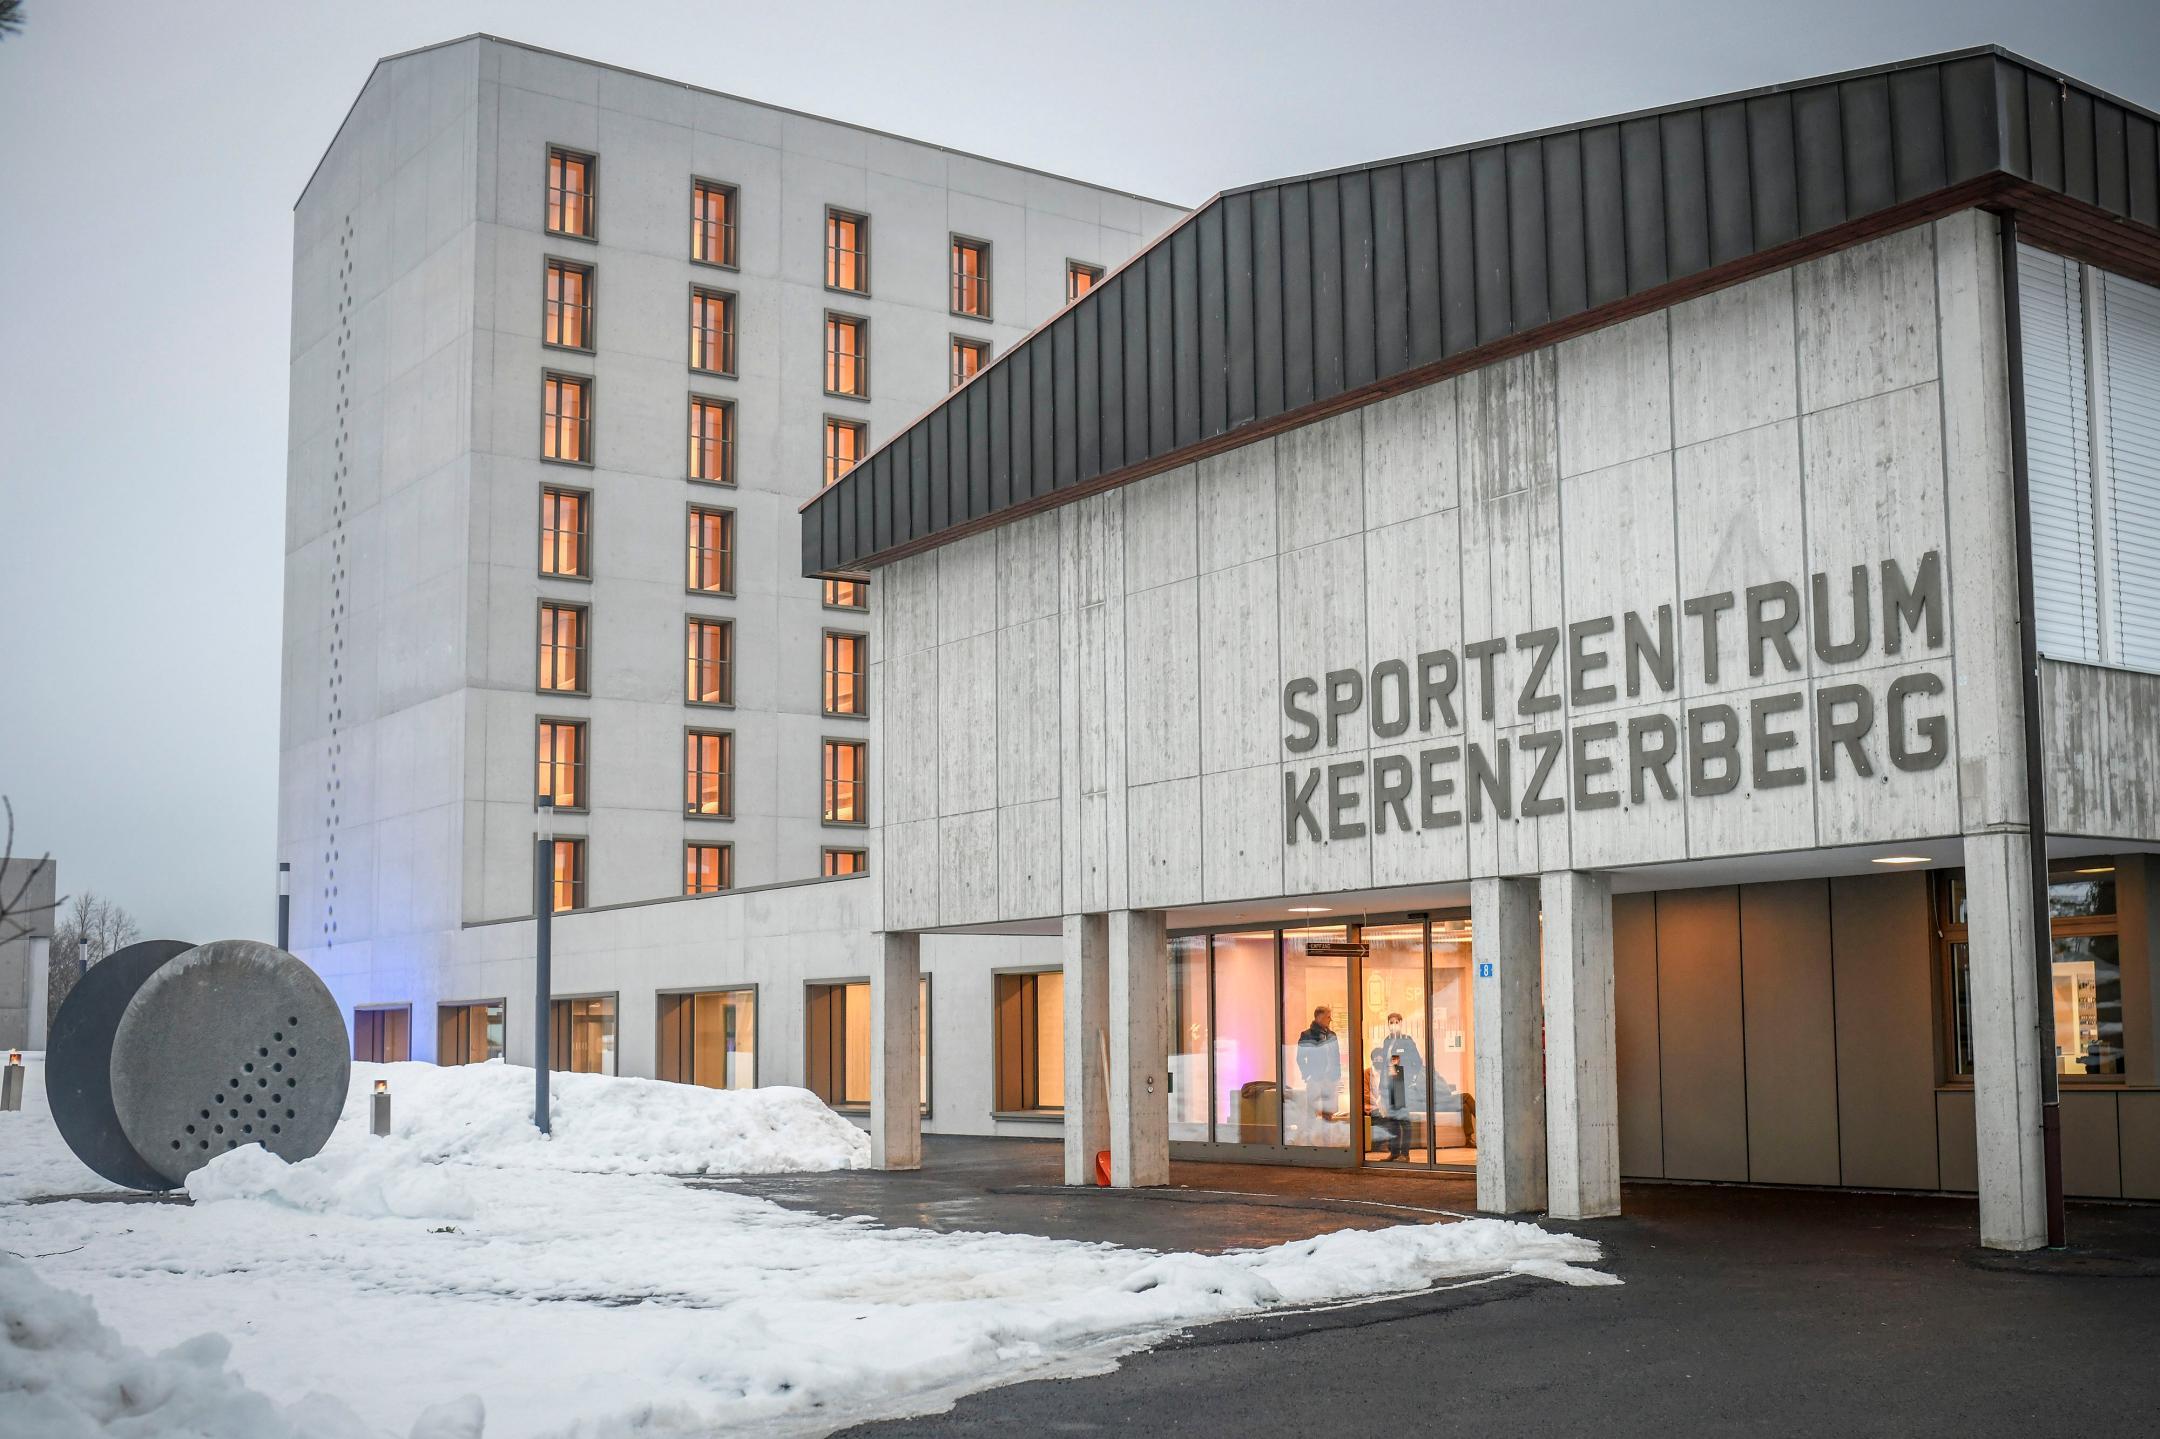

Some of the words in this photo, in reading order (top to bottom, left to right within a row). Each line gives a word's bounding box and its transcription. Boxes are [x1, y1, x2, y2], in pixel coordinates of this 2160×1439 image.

[1284, 551, 1943, 753] SPORTZENTRUM
[1284, 672, 1948, 845] KERENZERBERG
[1483, 964, 1489, 977] 8
